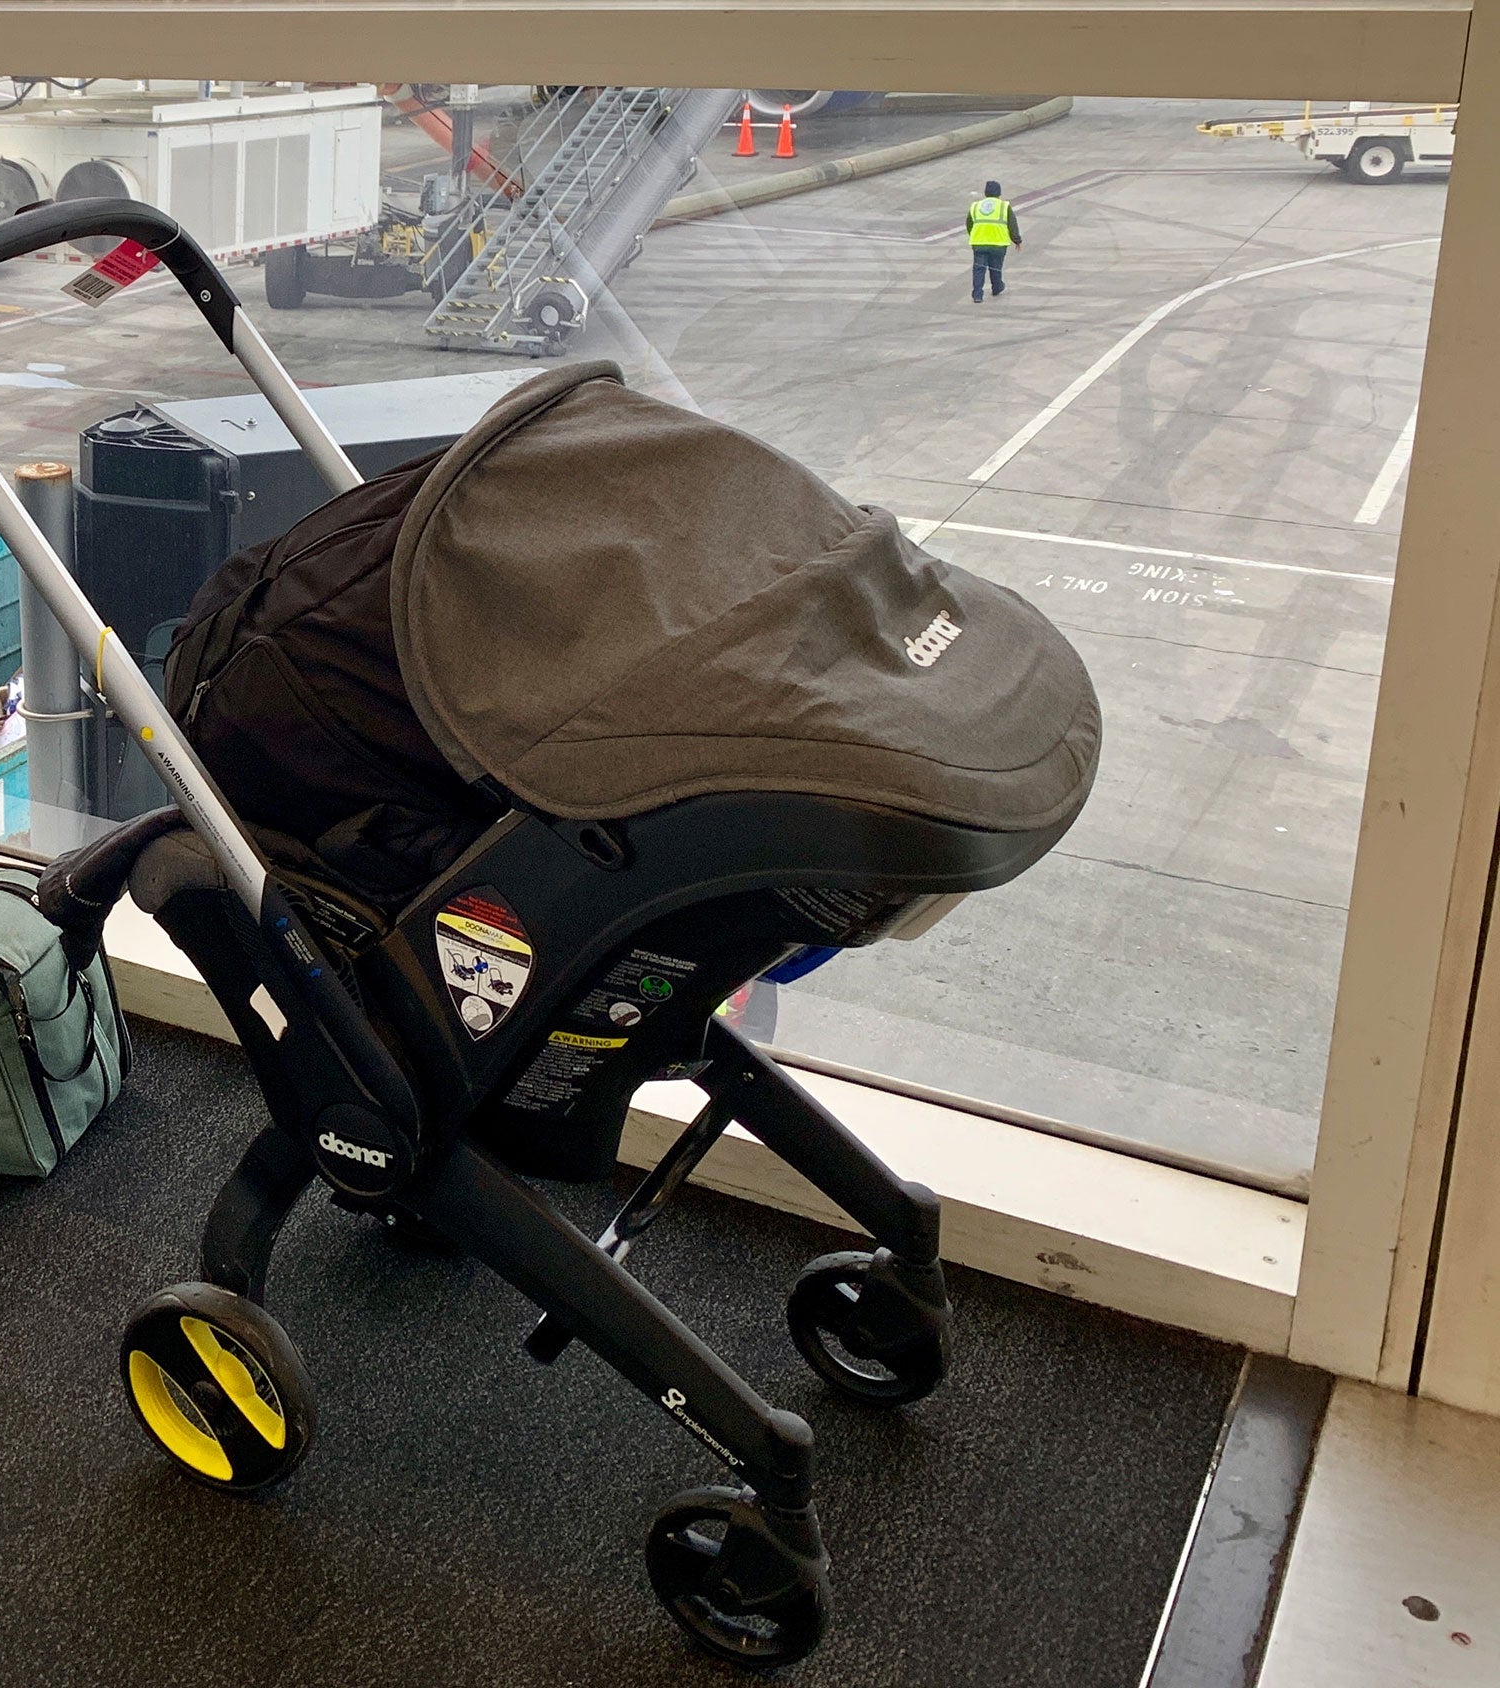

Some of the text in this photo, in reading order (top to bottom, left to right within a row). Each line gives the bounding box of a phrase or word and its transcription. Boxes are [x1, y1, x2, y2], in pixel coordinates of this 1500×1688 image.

[1036, 574, 1108, 594] ONLY
[903, 613, 963, 667] doona
[163, 757, 195, 802] WARNING
[561, 1036, 612, 1047] WARNING
[318, 1131, 386, 1169] doona
